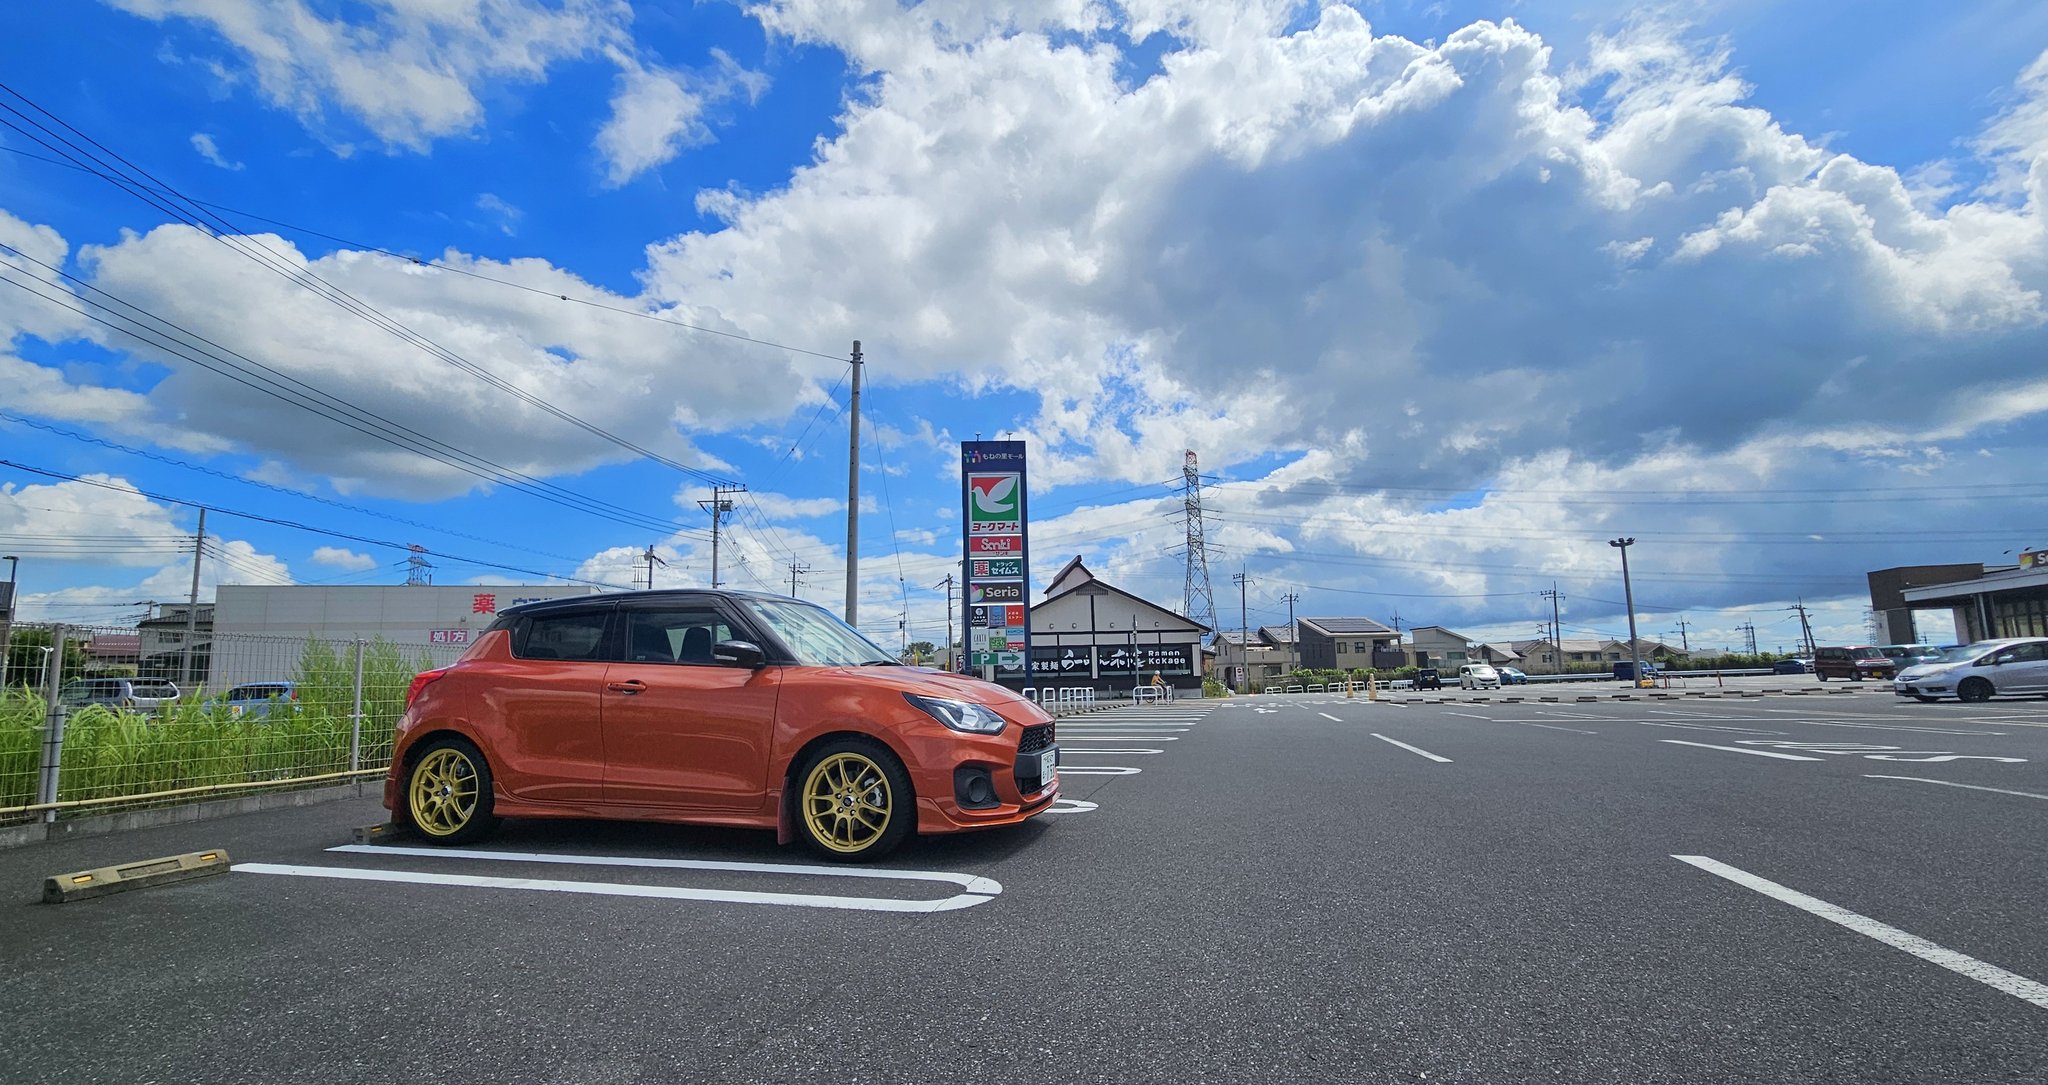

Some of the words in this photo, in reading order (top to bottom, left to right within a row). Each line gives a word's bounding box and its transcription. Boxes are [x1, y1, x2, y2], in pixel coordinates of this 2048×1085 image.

[972, 522, 1018, 531] ヨークマート
[974, 561, 989, 575] 薬
[991, 567, 1019, 575] セイムス
[986, 586, 1019, 597] Seria
[473, 593, 495, 614] 薬
[433, 631, 465, 643] 処方
[981, 653, 990, 664] P
[1022, 660, 1059, 671] 家製麺
